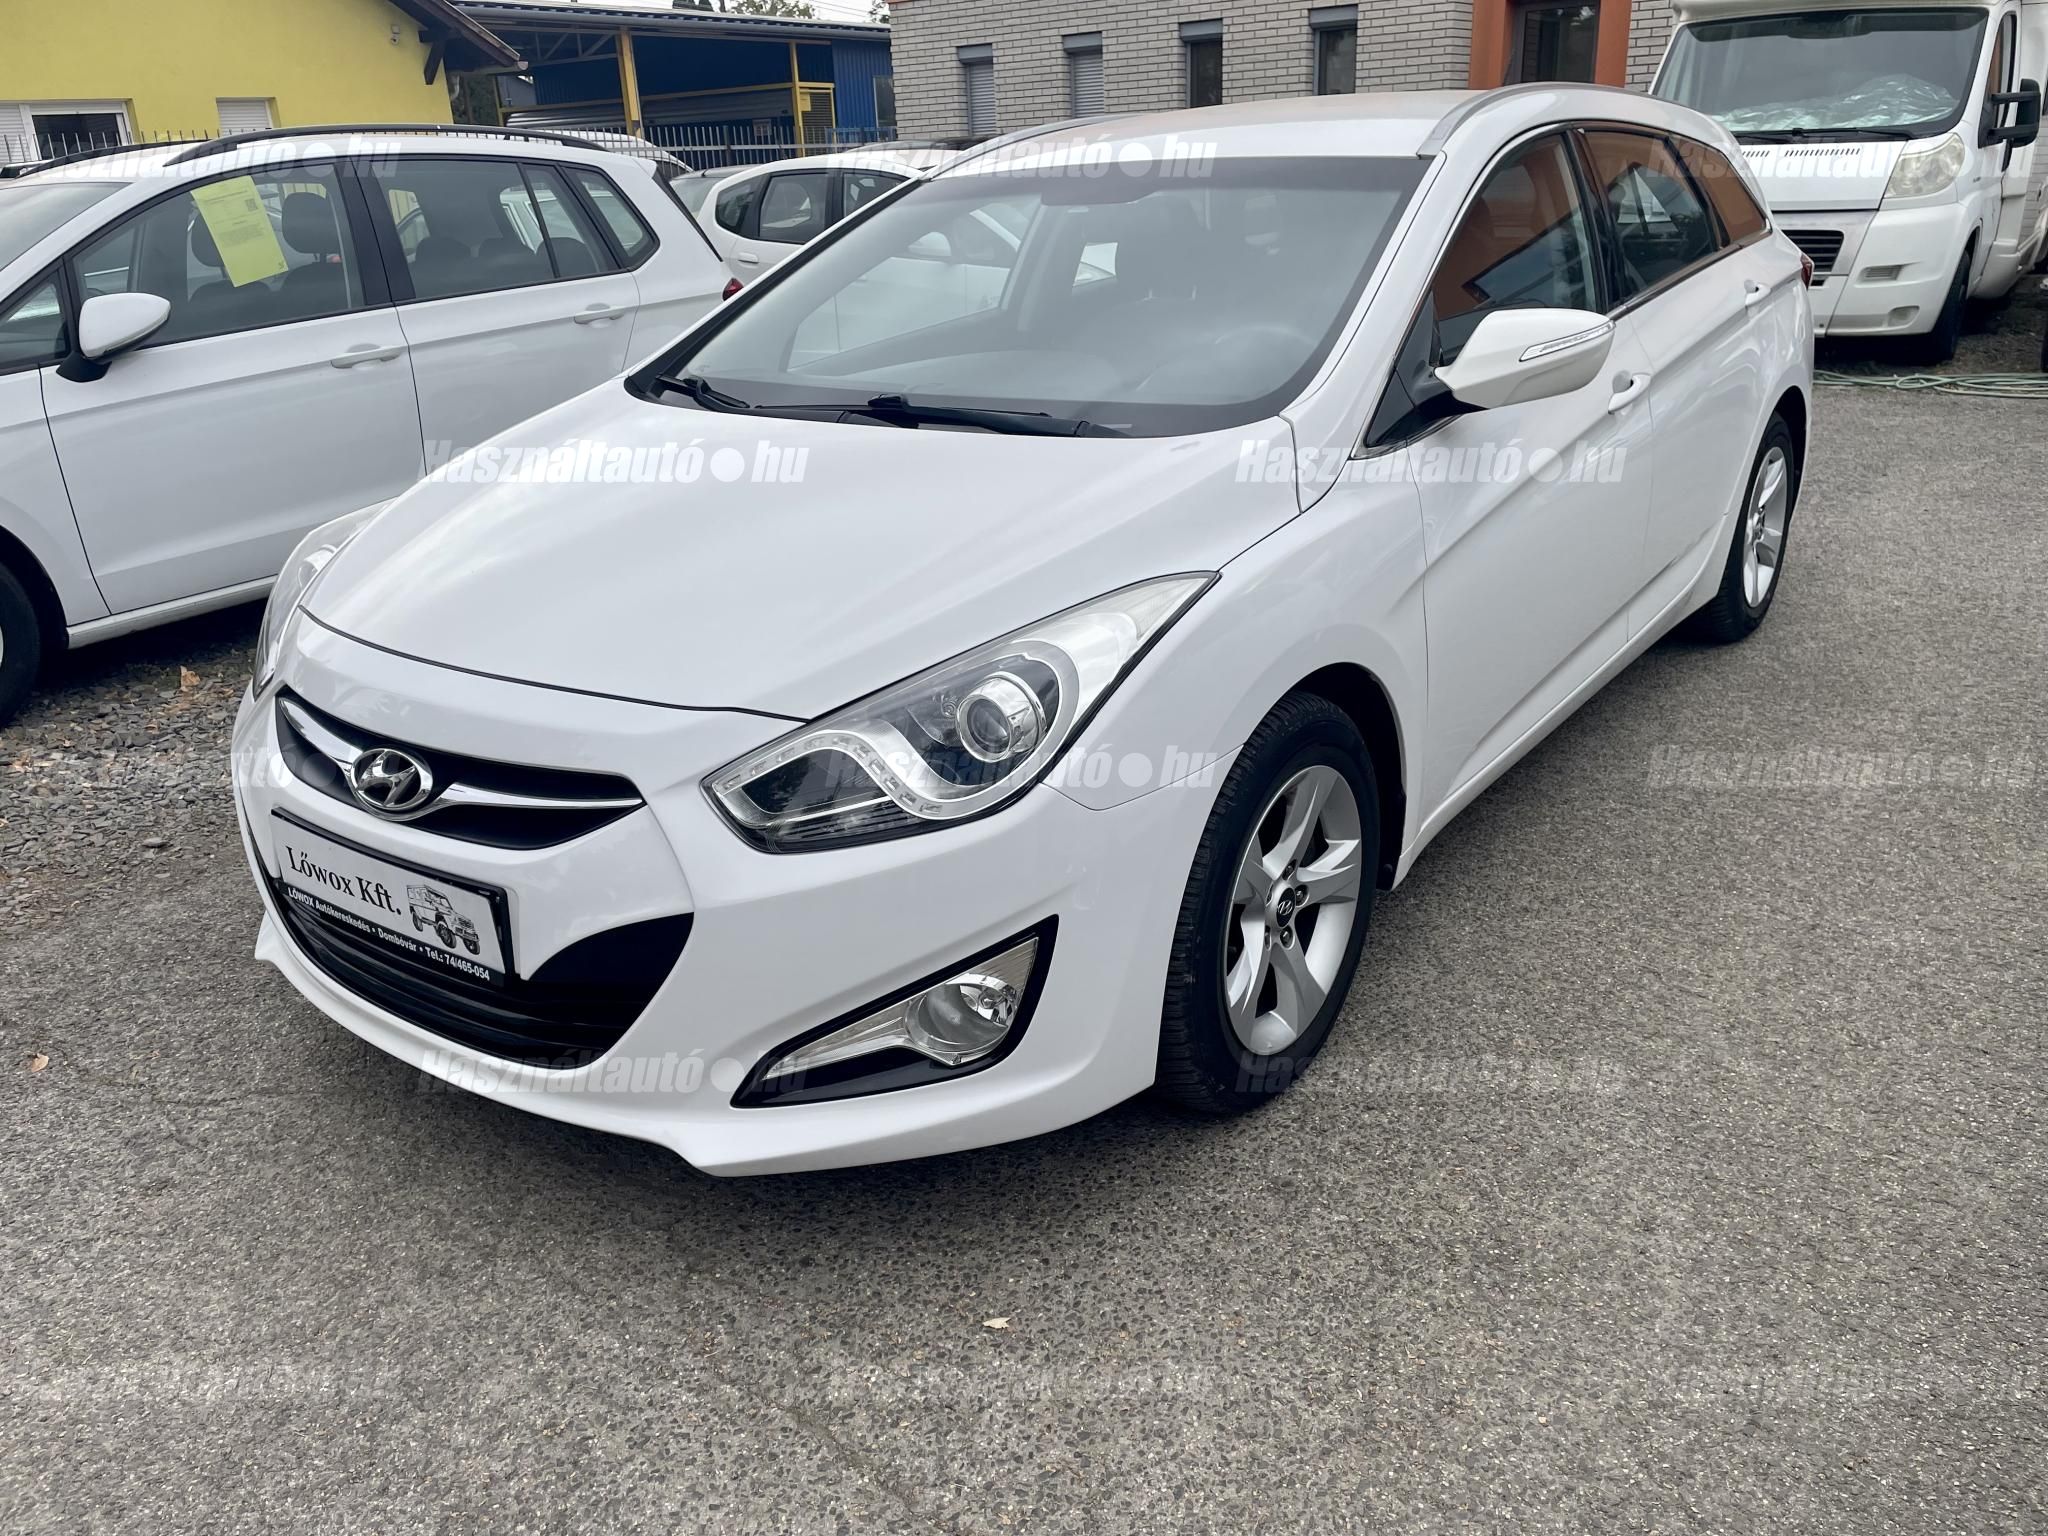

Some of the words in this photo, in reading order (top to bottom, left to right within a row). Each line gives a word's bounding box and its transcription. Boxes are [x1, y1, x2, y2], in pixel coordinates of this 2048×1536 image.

[286, 845, 356, 897] Lőwox
[355, 875, 402, 916] Kft.
[315, 900, 371, 933] Autókereskedés
[377, 927, 417, 952] Dombóvár
[424, 946, 444, 963] Tel.:
[444, 953, 491, 981] 74/465-054
